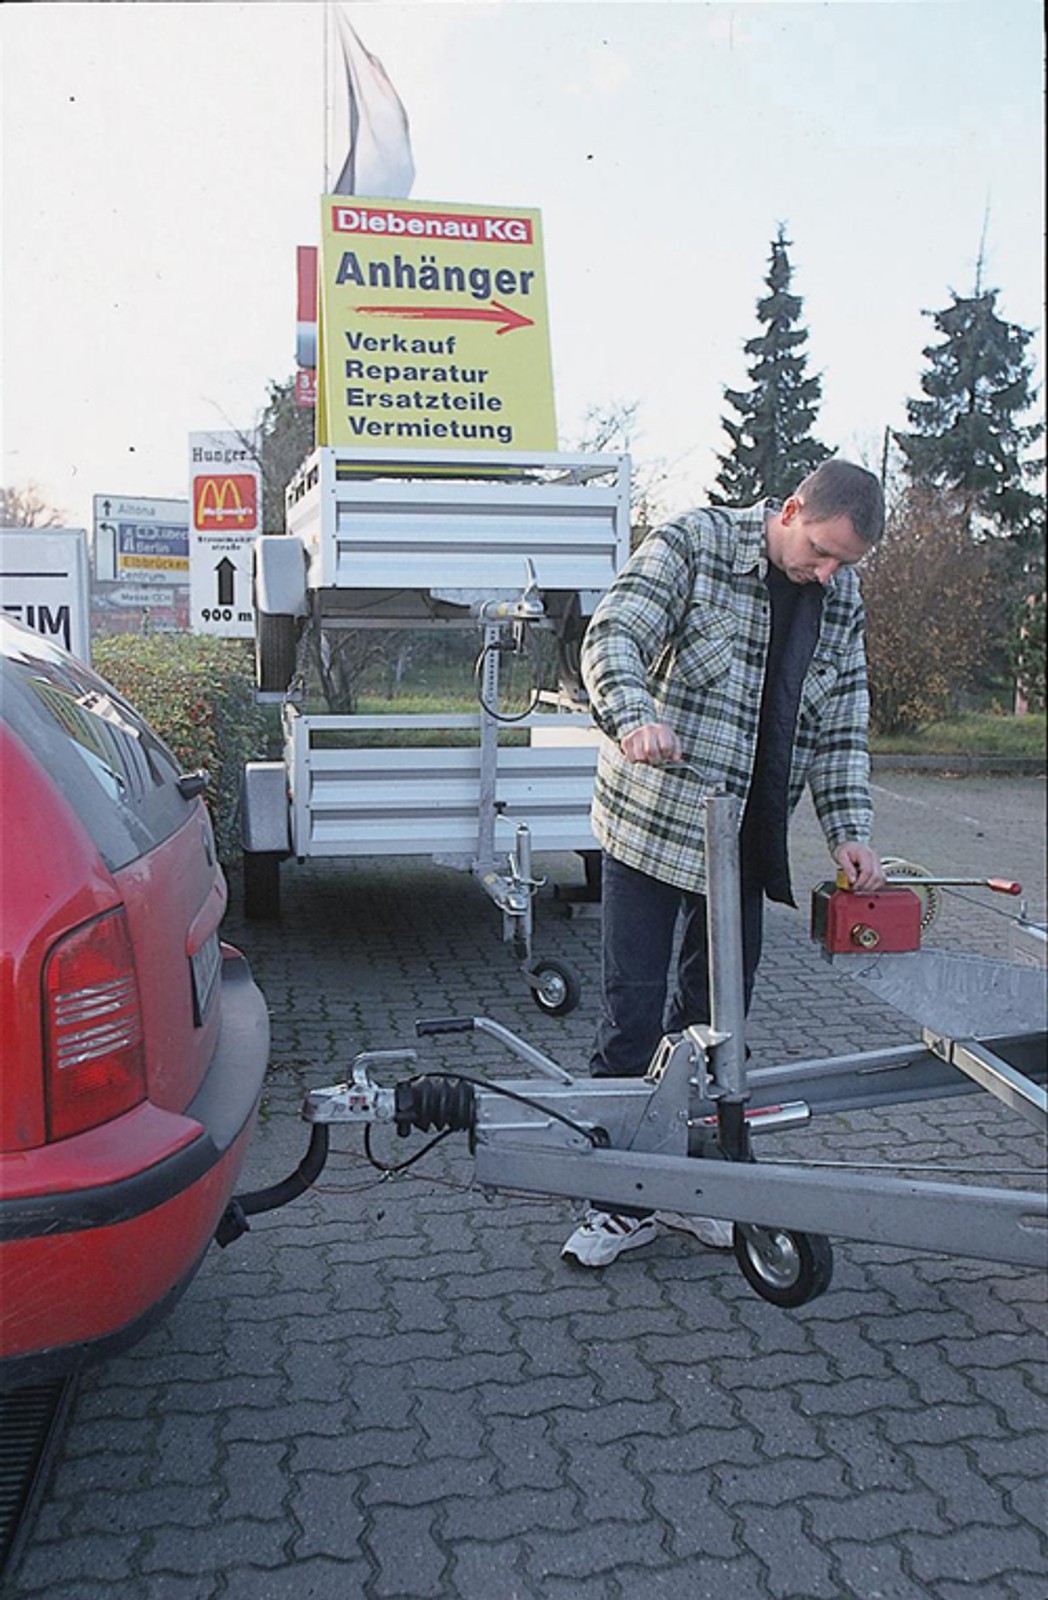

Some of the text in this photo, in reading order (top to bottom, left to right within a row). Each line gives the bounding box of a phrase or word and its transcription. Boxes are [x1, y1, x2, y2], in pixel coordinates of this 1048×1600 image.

[337, 209, 528, 241] Diebenau KG
[335, 251, 535, 300] Anhänger
[345, 331, 456, 355] Verkauf
[345, 359, 489, 384] Reparatur
[346, 387, 502, 411] Ersatzteile
[348, 415, 513, 444] Vermietung
[136, 540, 170, 553] Berlin
[201, 608, 253, 622] 900 m
[2, 605, 70, 653] IM
